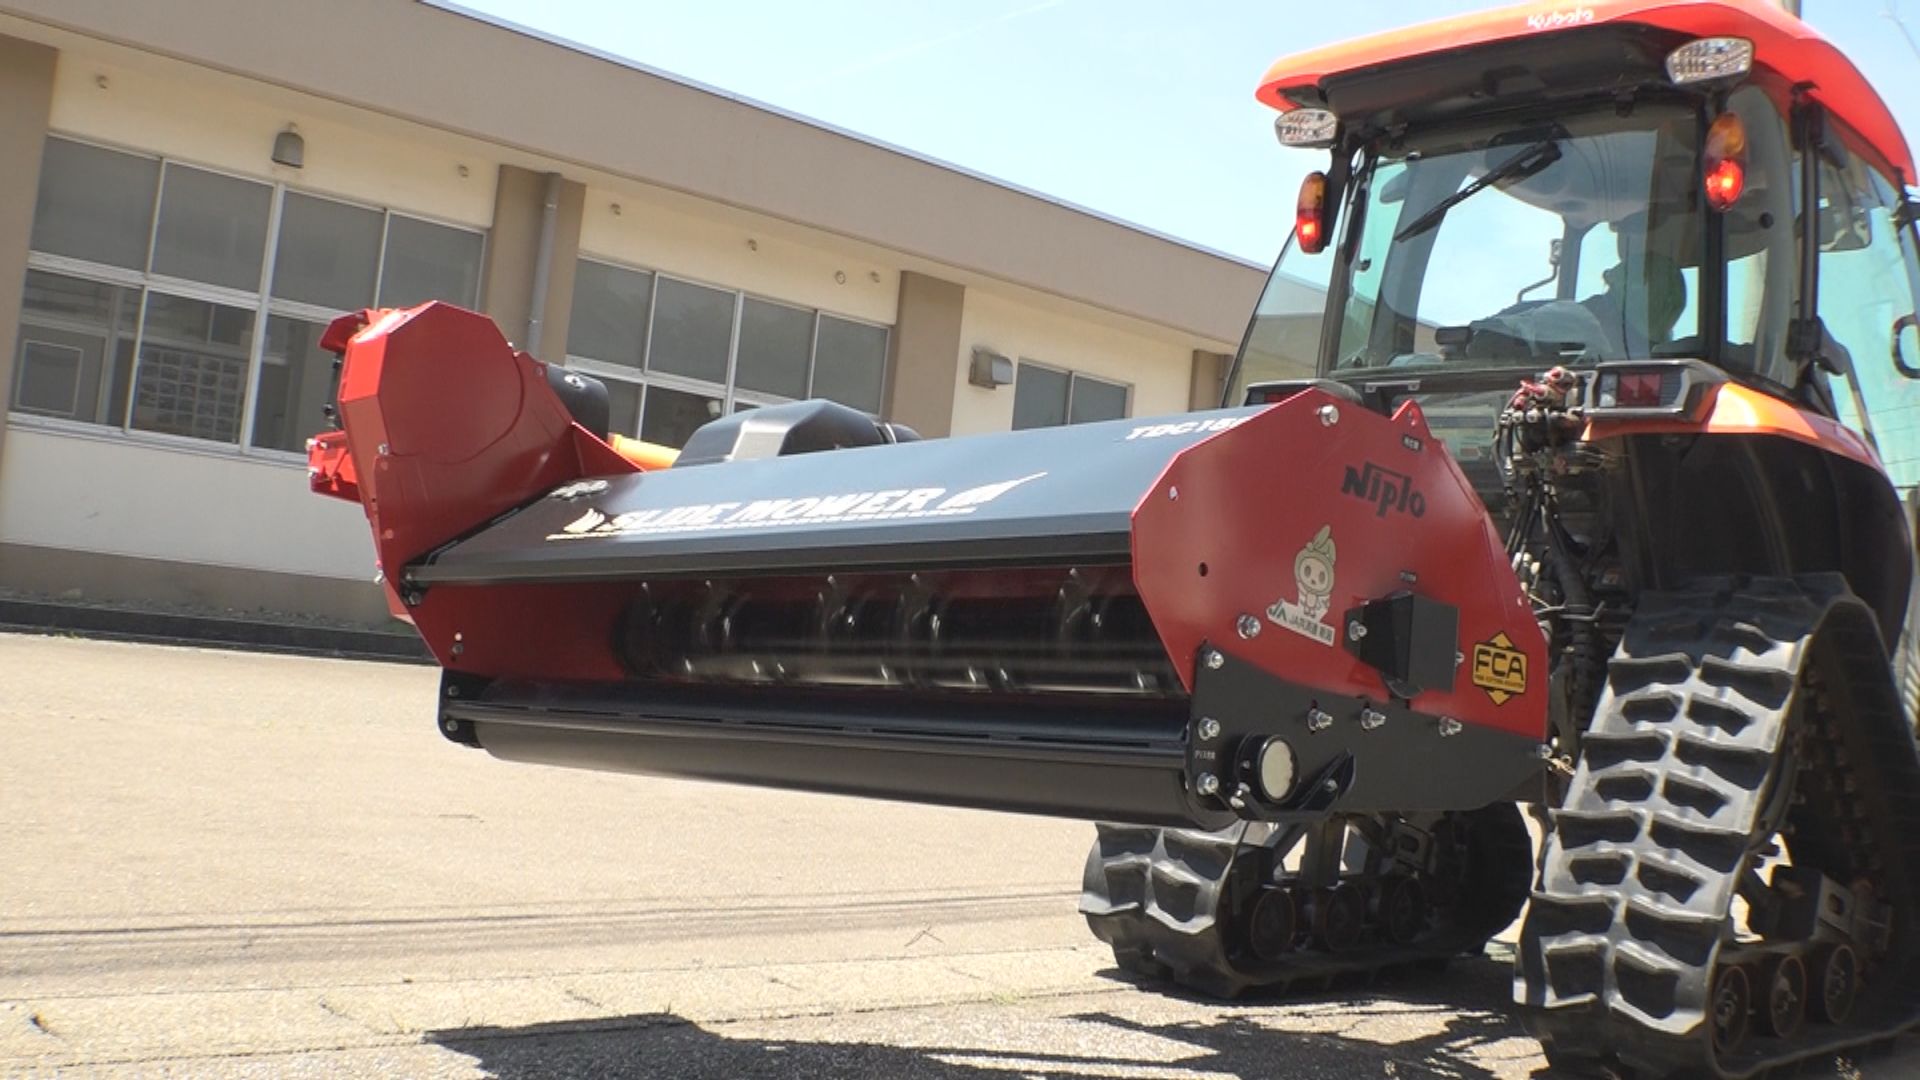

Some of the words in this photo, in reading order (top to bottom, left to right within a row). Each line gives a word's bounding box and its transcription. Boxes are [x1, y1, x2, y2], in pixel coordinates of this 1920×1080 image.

[1528, 8, 1595, 29] Kubota
[613, 502, 742, 529] SLIDE
[723, 487, 947, 523] MOWER
[1342, 461, 1426, 518] Niplo
[1475, 648, 1525, 681] FCA
